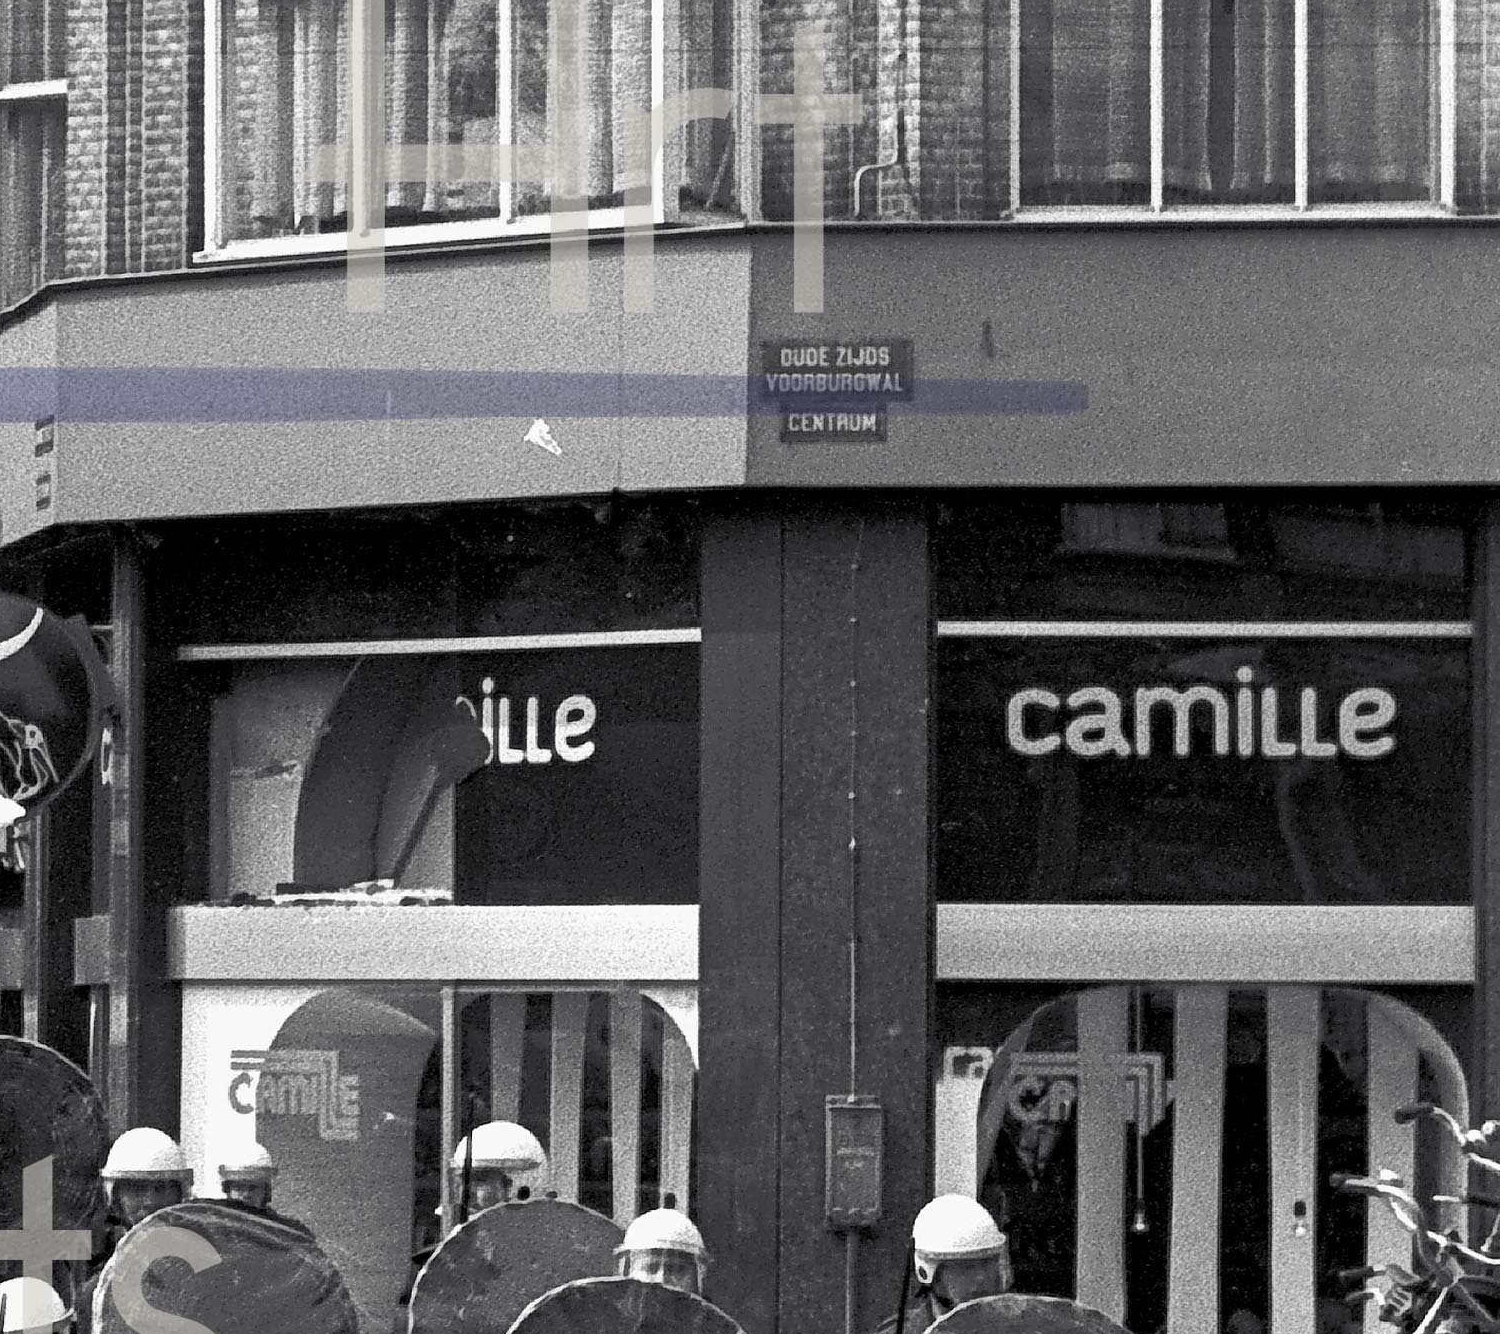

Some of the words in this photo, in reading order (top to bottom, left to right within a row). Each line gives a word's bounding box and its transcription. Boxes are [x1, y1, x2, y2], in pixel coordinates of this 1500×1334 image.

[780, 347, 831, 367] OUDE
[835, 345, 891, 367] ZIJDS
[765, 371, 904, 393] VOORBURGWAL
[788, 413, 877, 433] CENTRUM
[1007, 665, 1397, 757] camille
